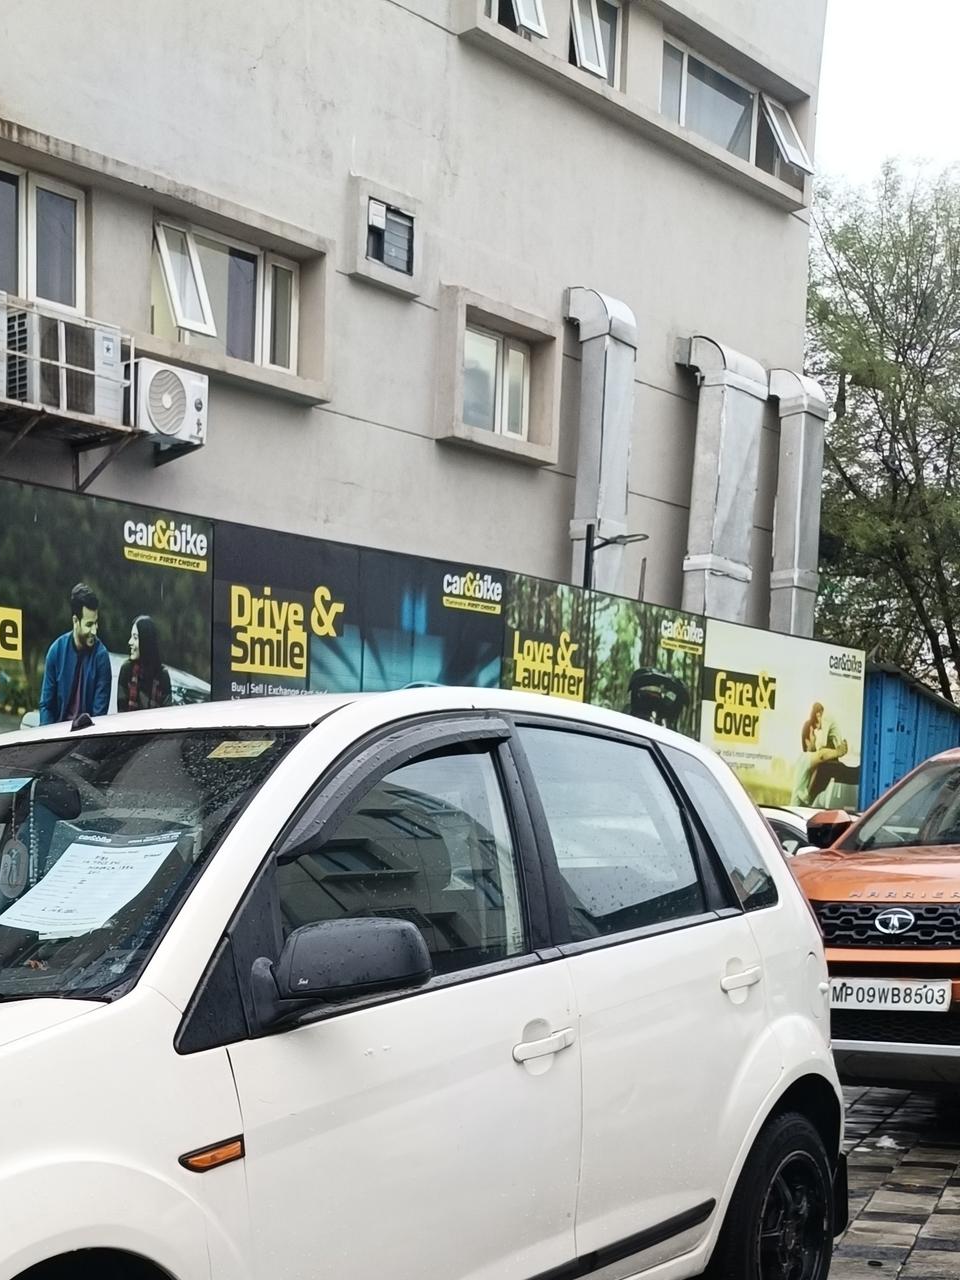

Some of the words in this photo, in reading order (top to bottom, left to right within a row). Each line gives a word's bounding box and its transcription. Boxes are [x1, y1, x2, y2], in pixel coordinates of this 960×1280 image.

[123, 519, 208, 557] car&bike
[443, 571, 503, 601] car&bike
[230, 585, 304, 632] Drive
[310, 585, 345, 637] &
[230, 625, 305, 670] Smile
[513, 630, 554, 664] Love
[557, 631, 579, 668] &
[231, 681, 246, 695] Buy
[250, 683, 264, 695] Sell
[512, 659, 583, 696] Laughter
[715, 671, 753, 706] Care
[755, 671, 776, 710] &
[714, 702, 759, 737] Cover
[831, 985, 946, 1006] MP09WB8503
